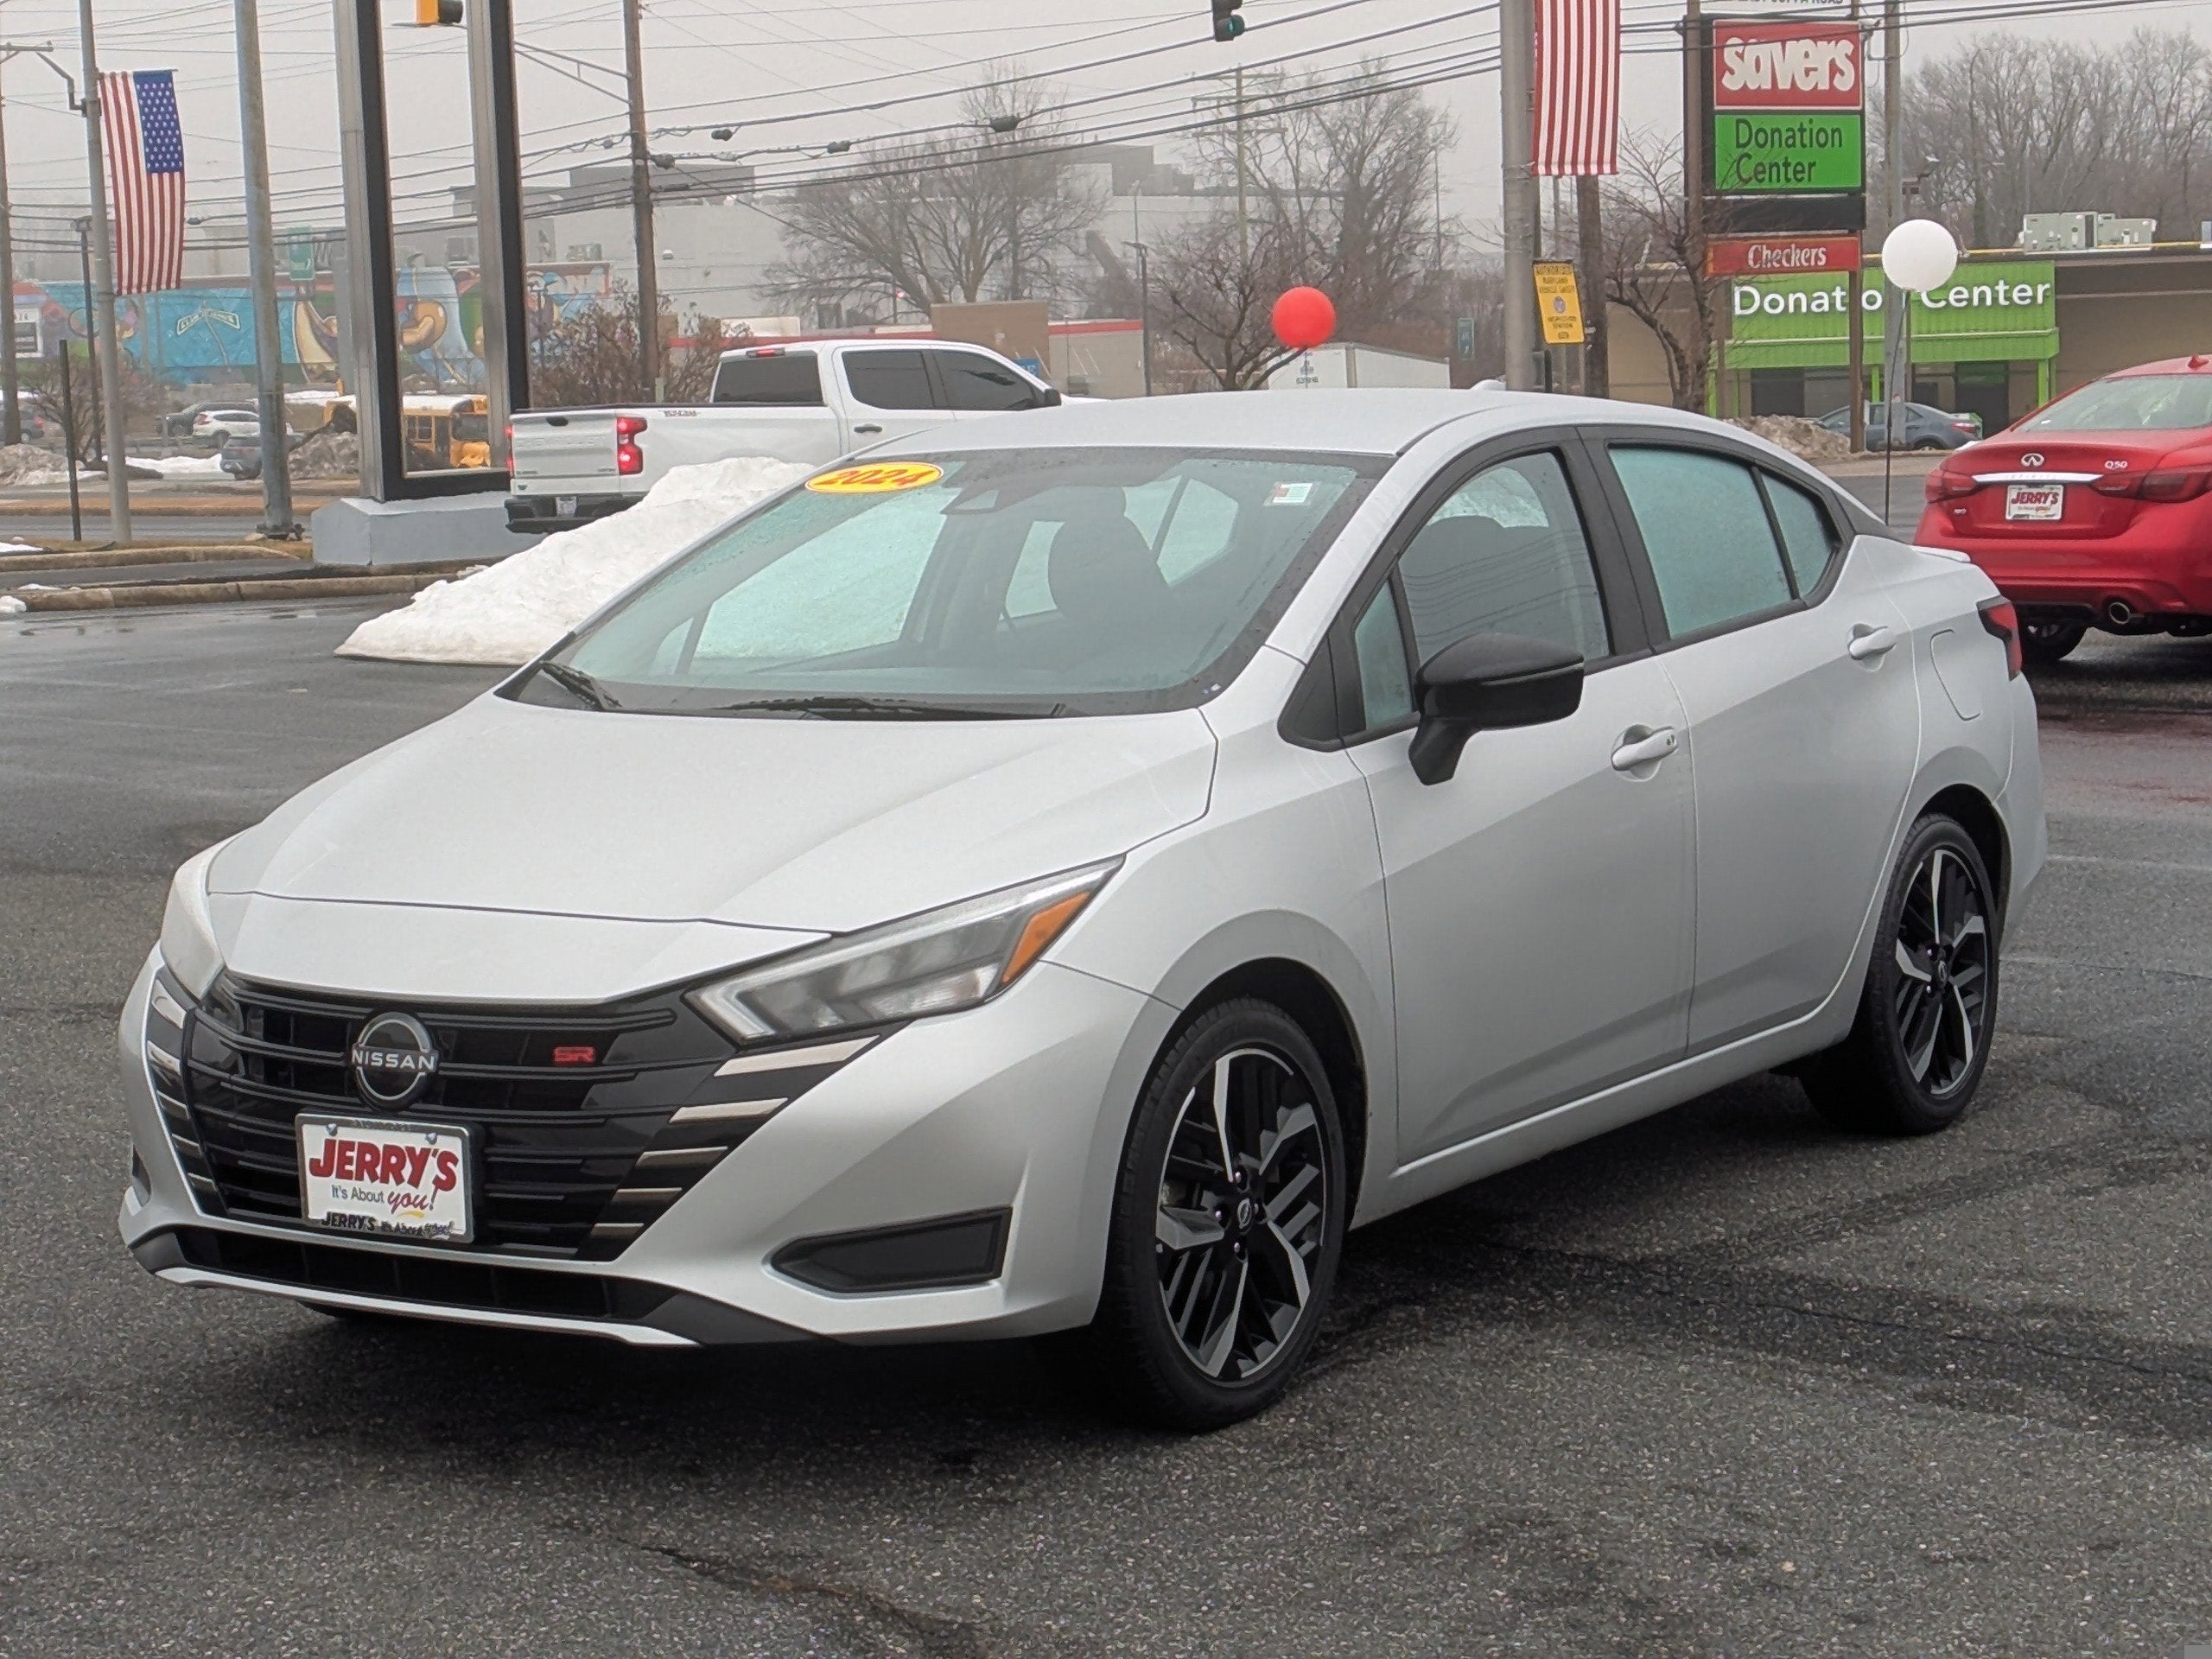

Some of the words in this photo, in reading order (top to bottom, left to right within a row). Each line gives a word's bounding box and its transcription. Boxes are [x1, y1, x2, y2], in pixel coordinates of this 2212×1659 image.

[1735, 118, 1843, 149] Donation
[1736, 152, 1816, 184] Center
[1748, 243, 1827, 268] Checkers
[1734, 285, 1906, 315] Donato
[813, 469, 936, 486] 2024
[2104, 461, 2128, 469] Q50
[2011, 492, 2059, 505] JERRY'S
[352, 1048, 435, 1071] NISSAN
[309, 1138, 460, 1192] JERRY'S
[332, 1184, 348, 1199] It's
[351, 1186, 385, 1204] About
[387, 1187, 439, 1215] you!
